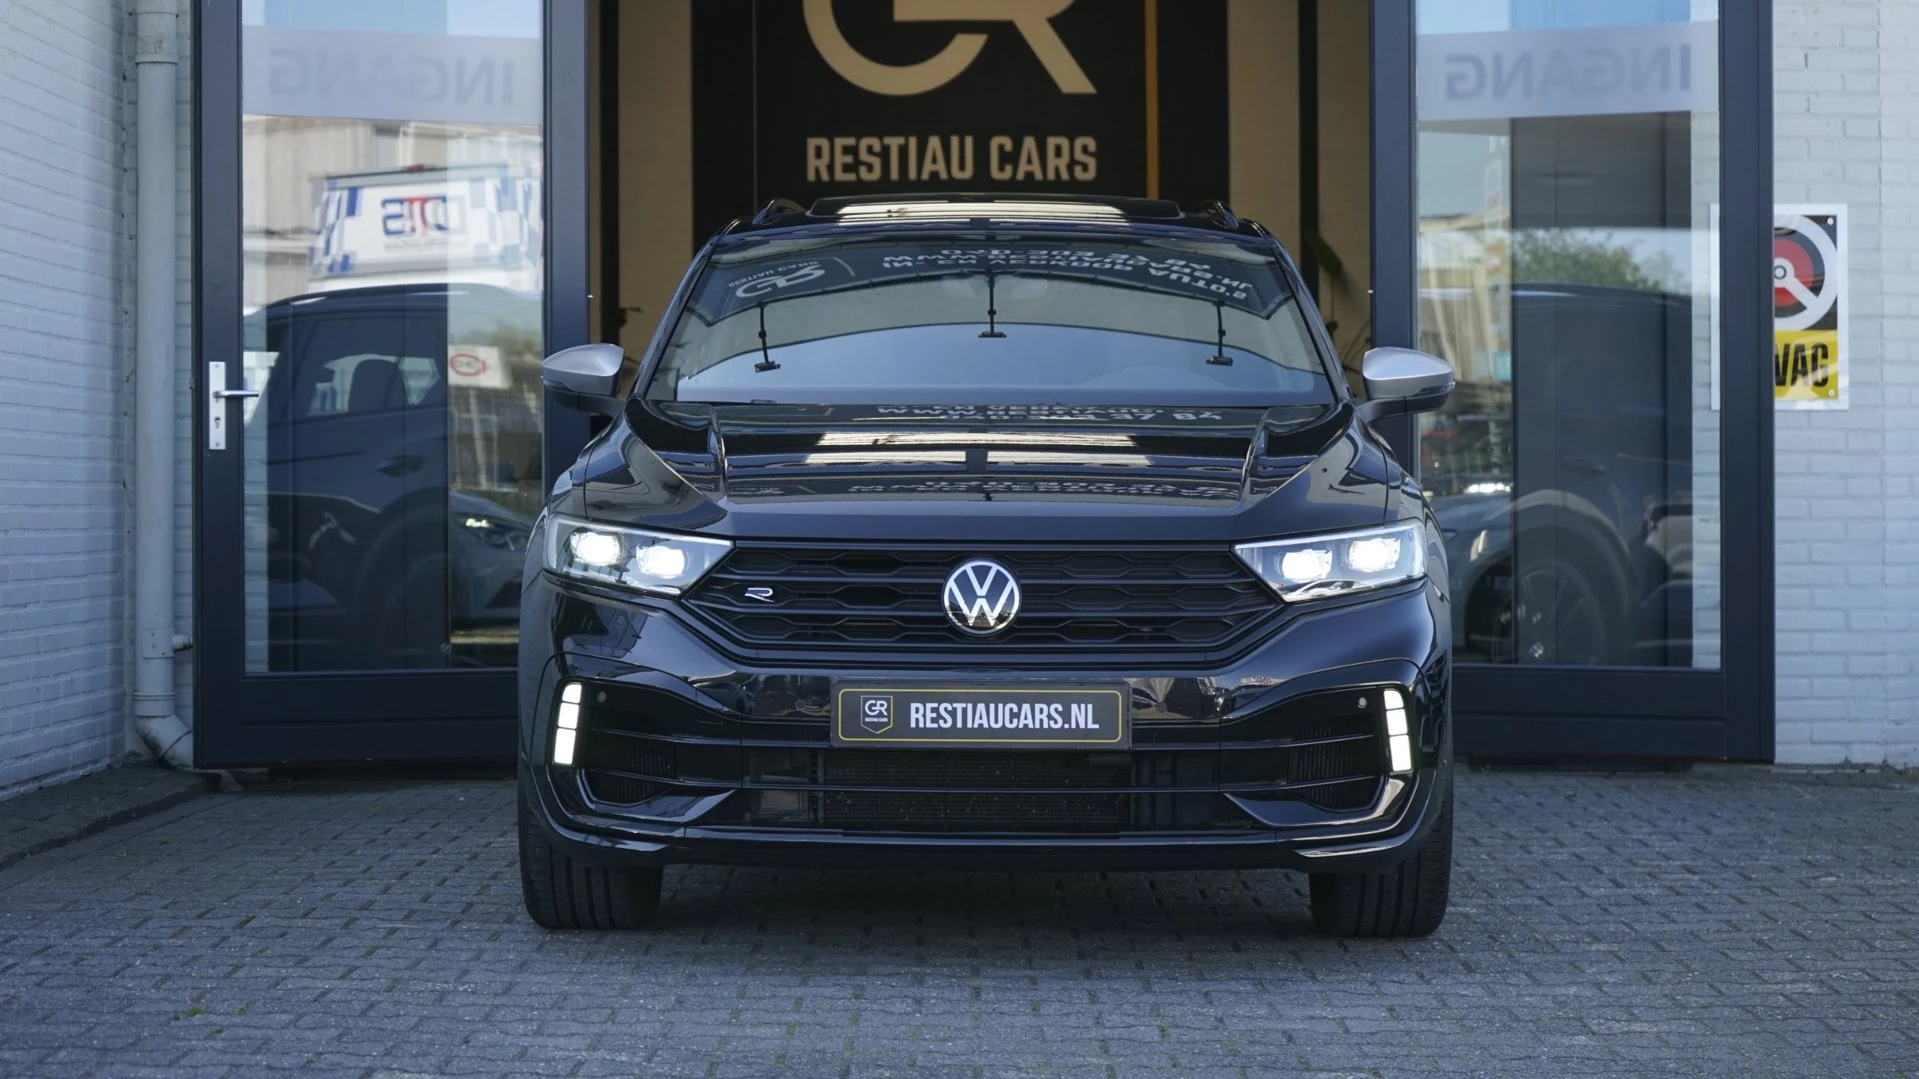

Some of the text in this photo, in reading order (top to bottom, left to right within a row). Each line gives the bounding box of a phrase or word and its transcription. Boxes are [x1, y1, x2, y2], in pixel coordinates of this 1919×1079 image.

[807, 135, 1097, 181] RESTIAU CARS
[910, 702, 1099, 729] RESTIAUCARS.NL
